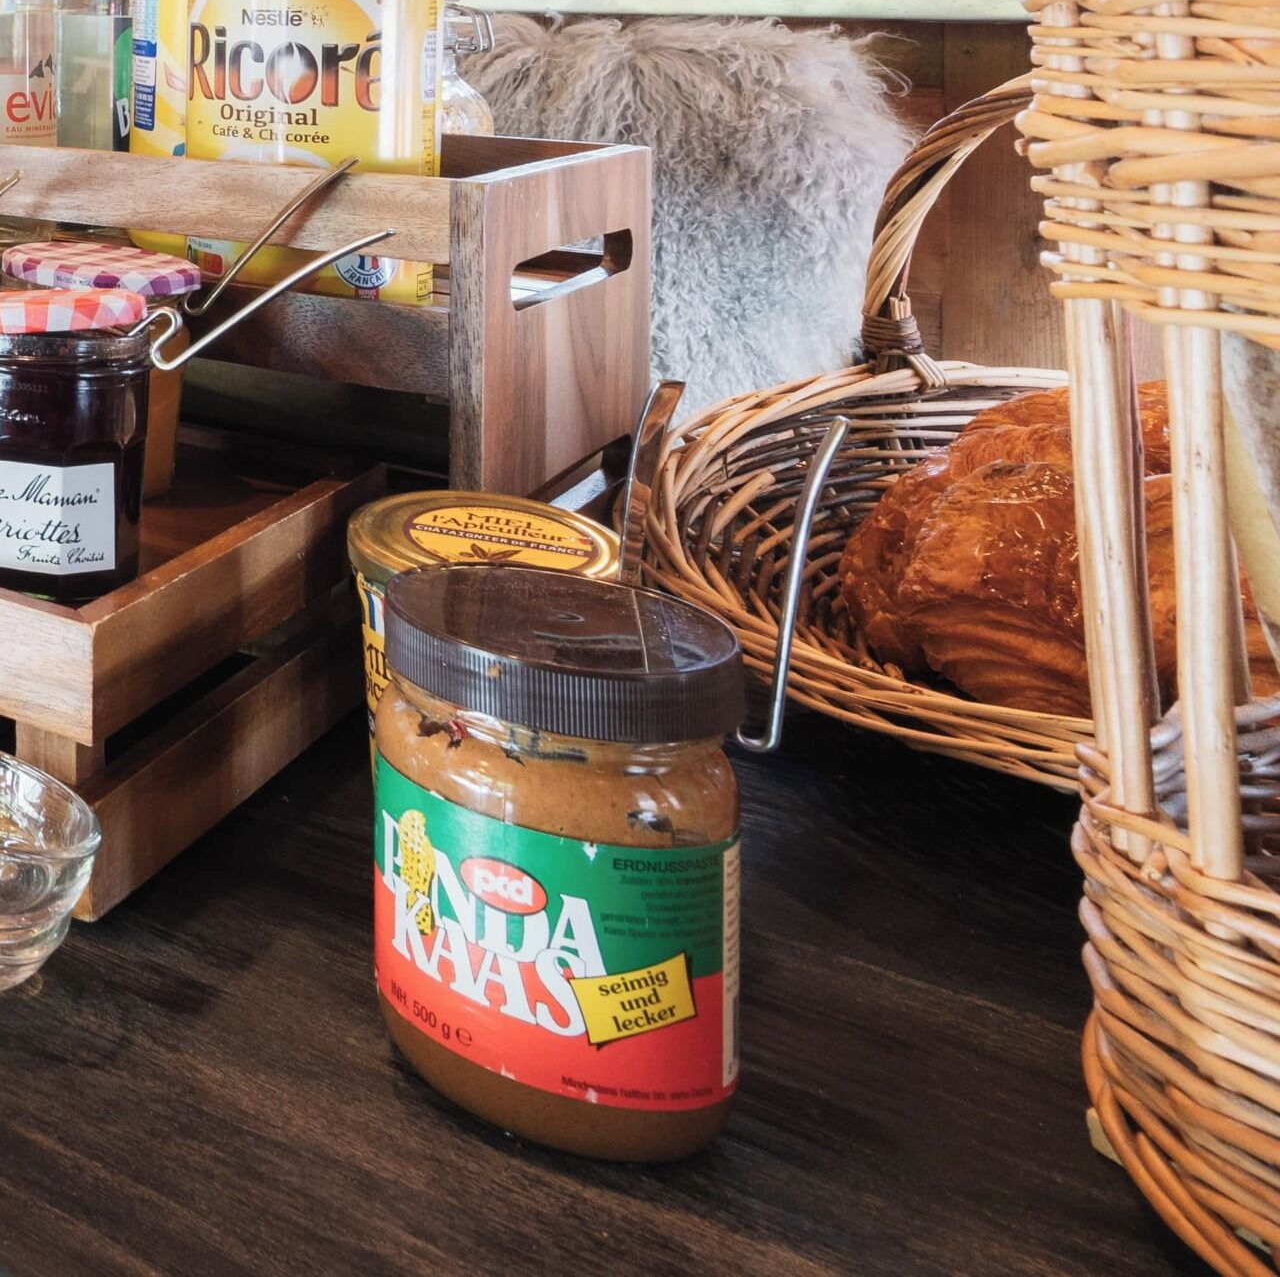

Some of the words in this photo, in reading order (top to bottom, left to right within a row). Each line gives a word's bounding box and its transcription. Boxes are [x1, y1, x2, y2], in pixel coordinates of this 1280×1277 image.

[241, 7, 303, 26] Nestlé
[188, 21, 383, 112] Ricoré
[6, 83, 57, 123] evi
[212, 124, 239, 138] Café
[243, 128, 254, 140] &
[259, 128, 330, 144] Chcorée
[343, 267, 386, 286] FRANÇAI
[11, 473, 98, 507] Maman
[431, 514, 568, 543] l'Apiculteur
[466, 512, 545, 532] MIEL
[17, 544, 62, 565] Fruits
[66, 545, 105, 565] Choisis
[415, 523, 509, 545] CHÂTAIGNIER
[511, 539, 528, 547] DE
[529, 541, 586, 557] FRANCE
[612, 855, 721, 874] ERDNUSSPASTE
[382, 809, 608, 979] PNDA
[391, 873, 587, 1037] KAAS
[597, 969, 669, 997] seimig
[390, 980, 410, 1010] INH.
[413, 1001, 437, 1029] 500
[441, 1016, 451, 1040] g
[619, 989, 662, 1012] und
[612, 1003, 677, 1033] lecker
